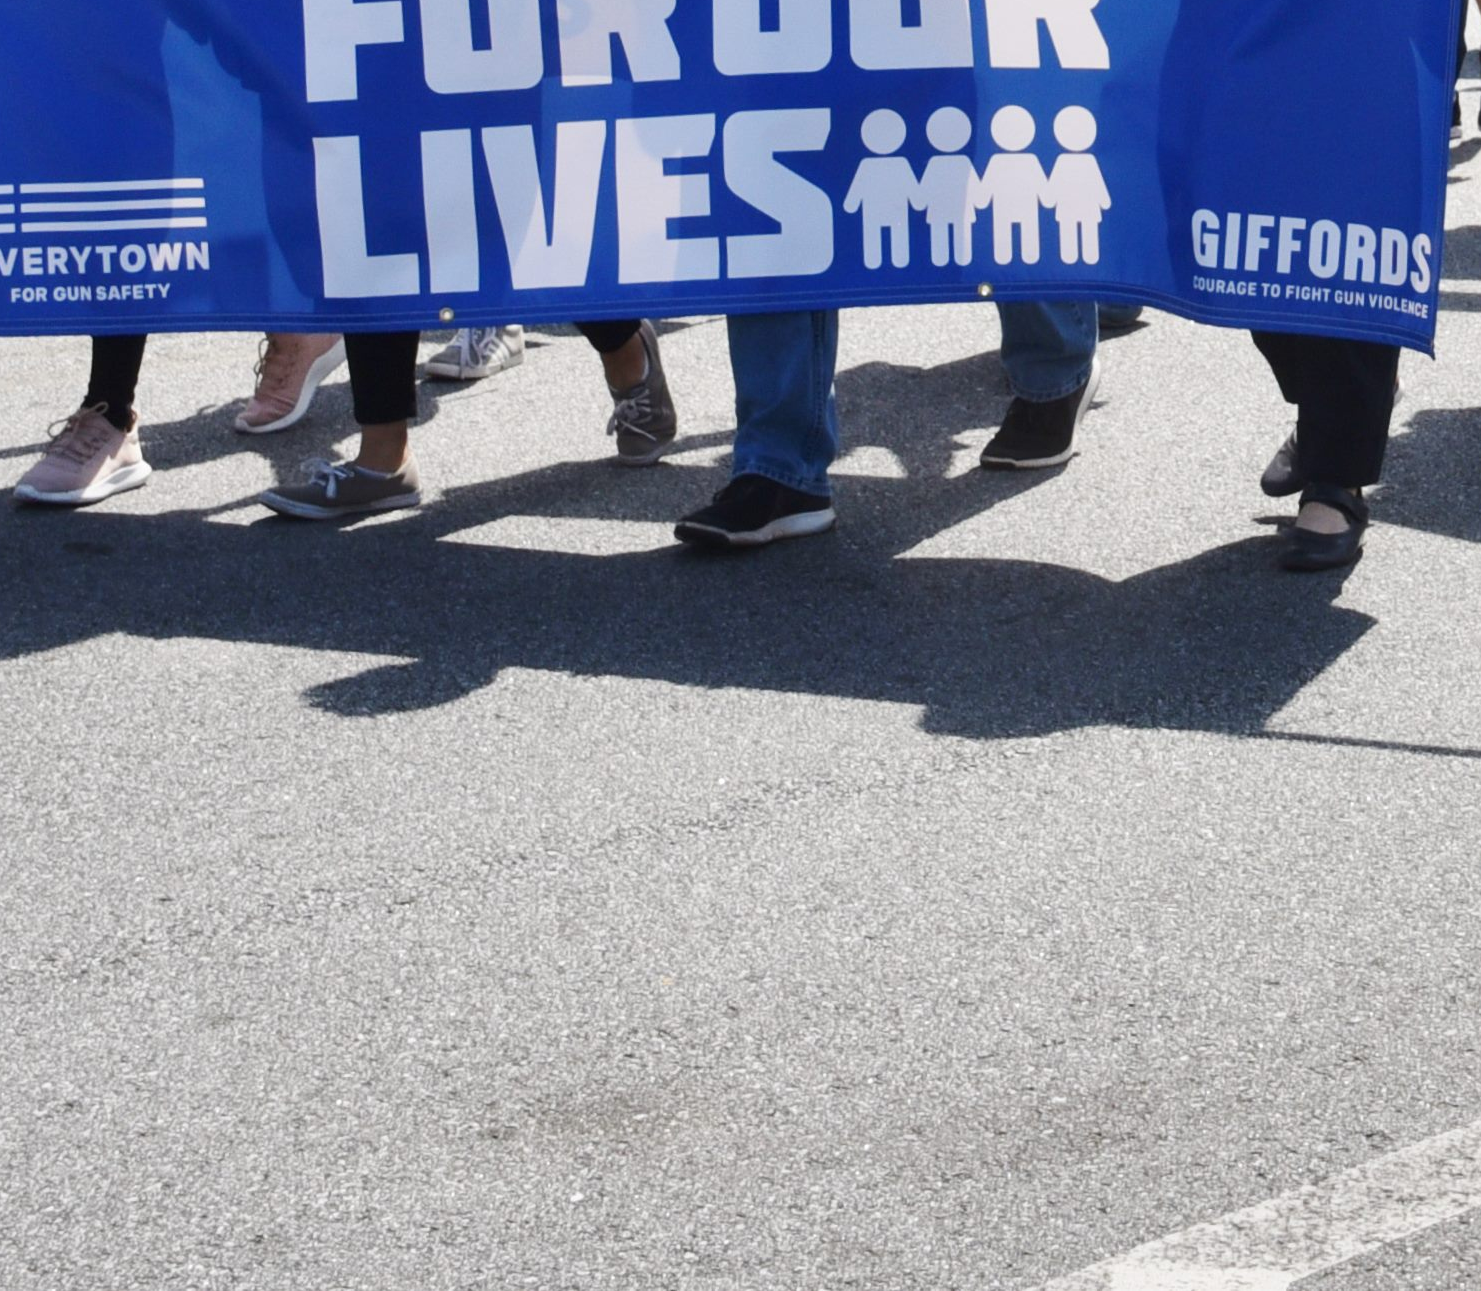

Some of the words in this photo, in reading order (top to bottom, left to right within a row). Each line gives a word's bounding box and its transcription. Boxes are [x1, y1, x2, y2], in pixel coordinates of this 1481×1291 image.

[312, 107, 834, 299] LIVES
[1191, 208, 1432, 294] GIFFORDS
[10, 287, 47, 303] FOR
[53, 285, 92, 301] GUN
[95, 283, 171, 301] SAFETY
[1193, 275, 1257, 297] COURAGE
[1261, 282, 1281, 298] TO
[1285, 285, 1331, 303] FIGHT
[1334, 290, 1365, 306] GUN
[1368, 294, 1429, 319] VIOLENCE
